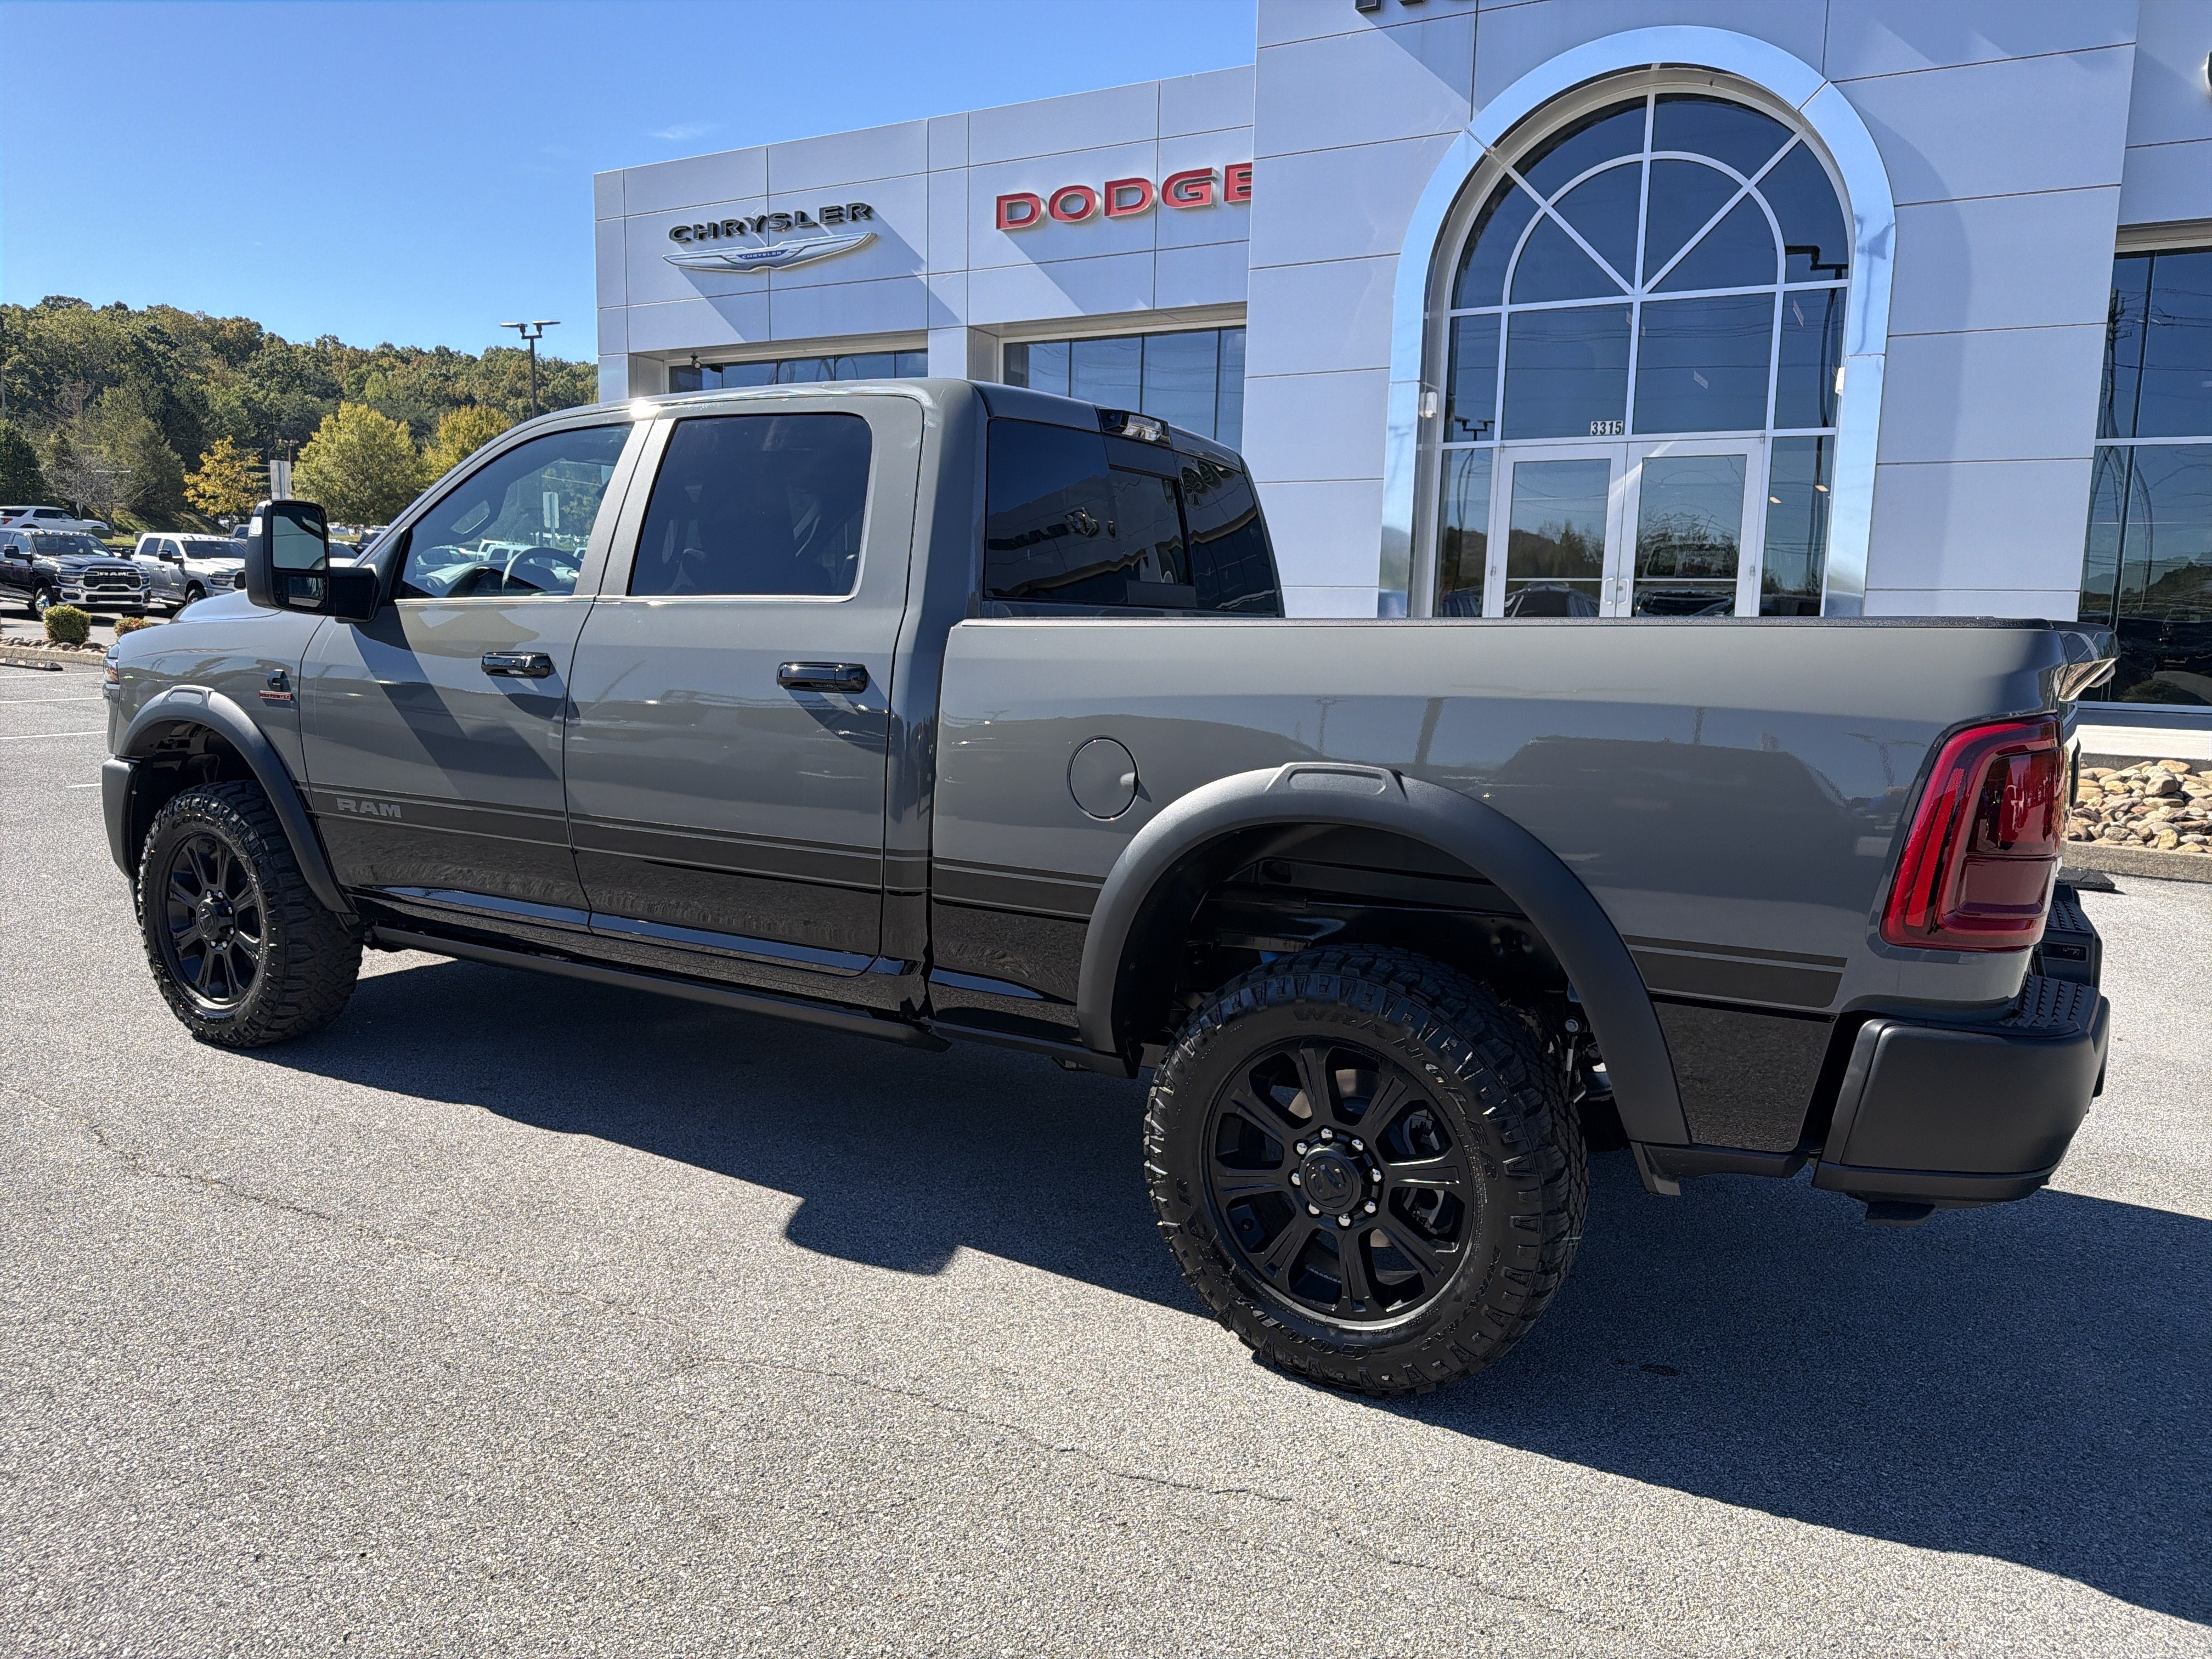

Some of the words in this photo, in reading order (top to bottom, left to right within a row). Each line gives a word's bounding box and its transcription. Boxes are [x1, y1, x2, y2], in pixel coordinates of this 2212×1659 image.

[996, 162, 1252, 229] DODGE
[669, 202, 873, 242] CHRYSLER
[1592, 421, 1622, 435] 3315
[336, 798, 402, 818] RAM
[1293, 1008, 1498, 1180] WRANGLER
